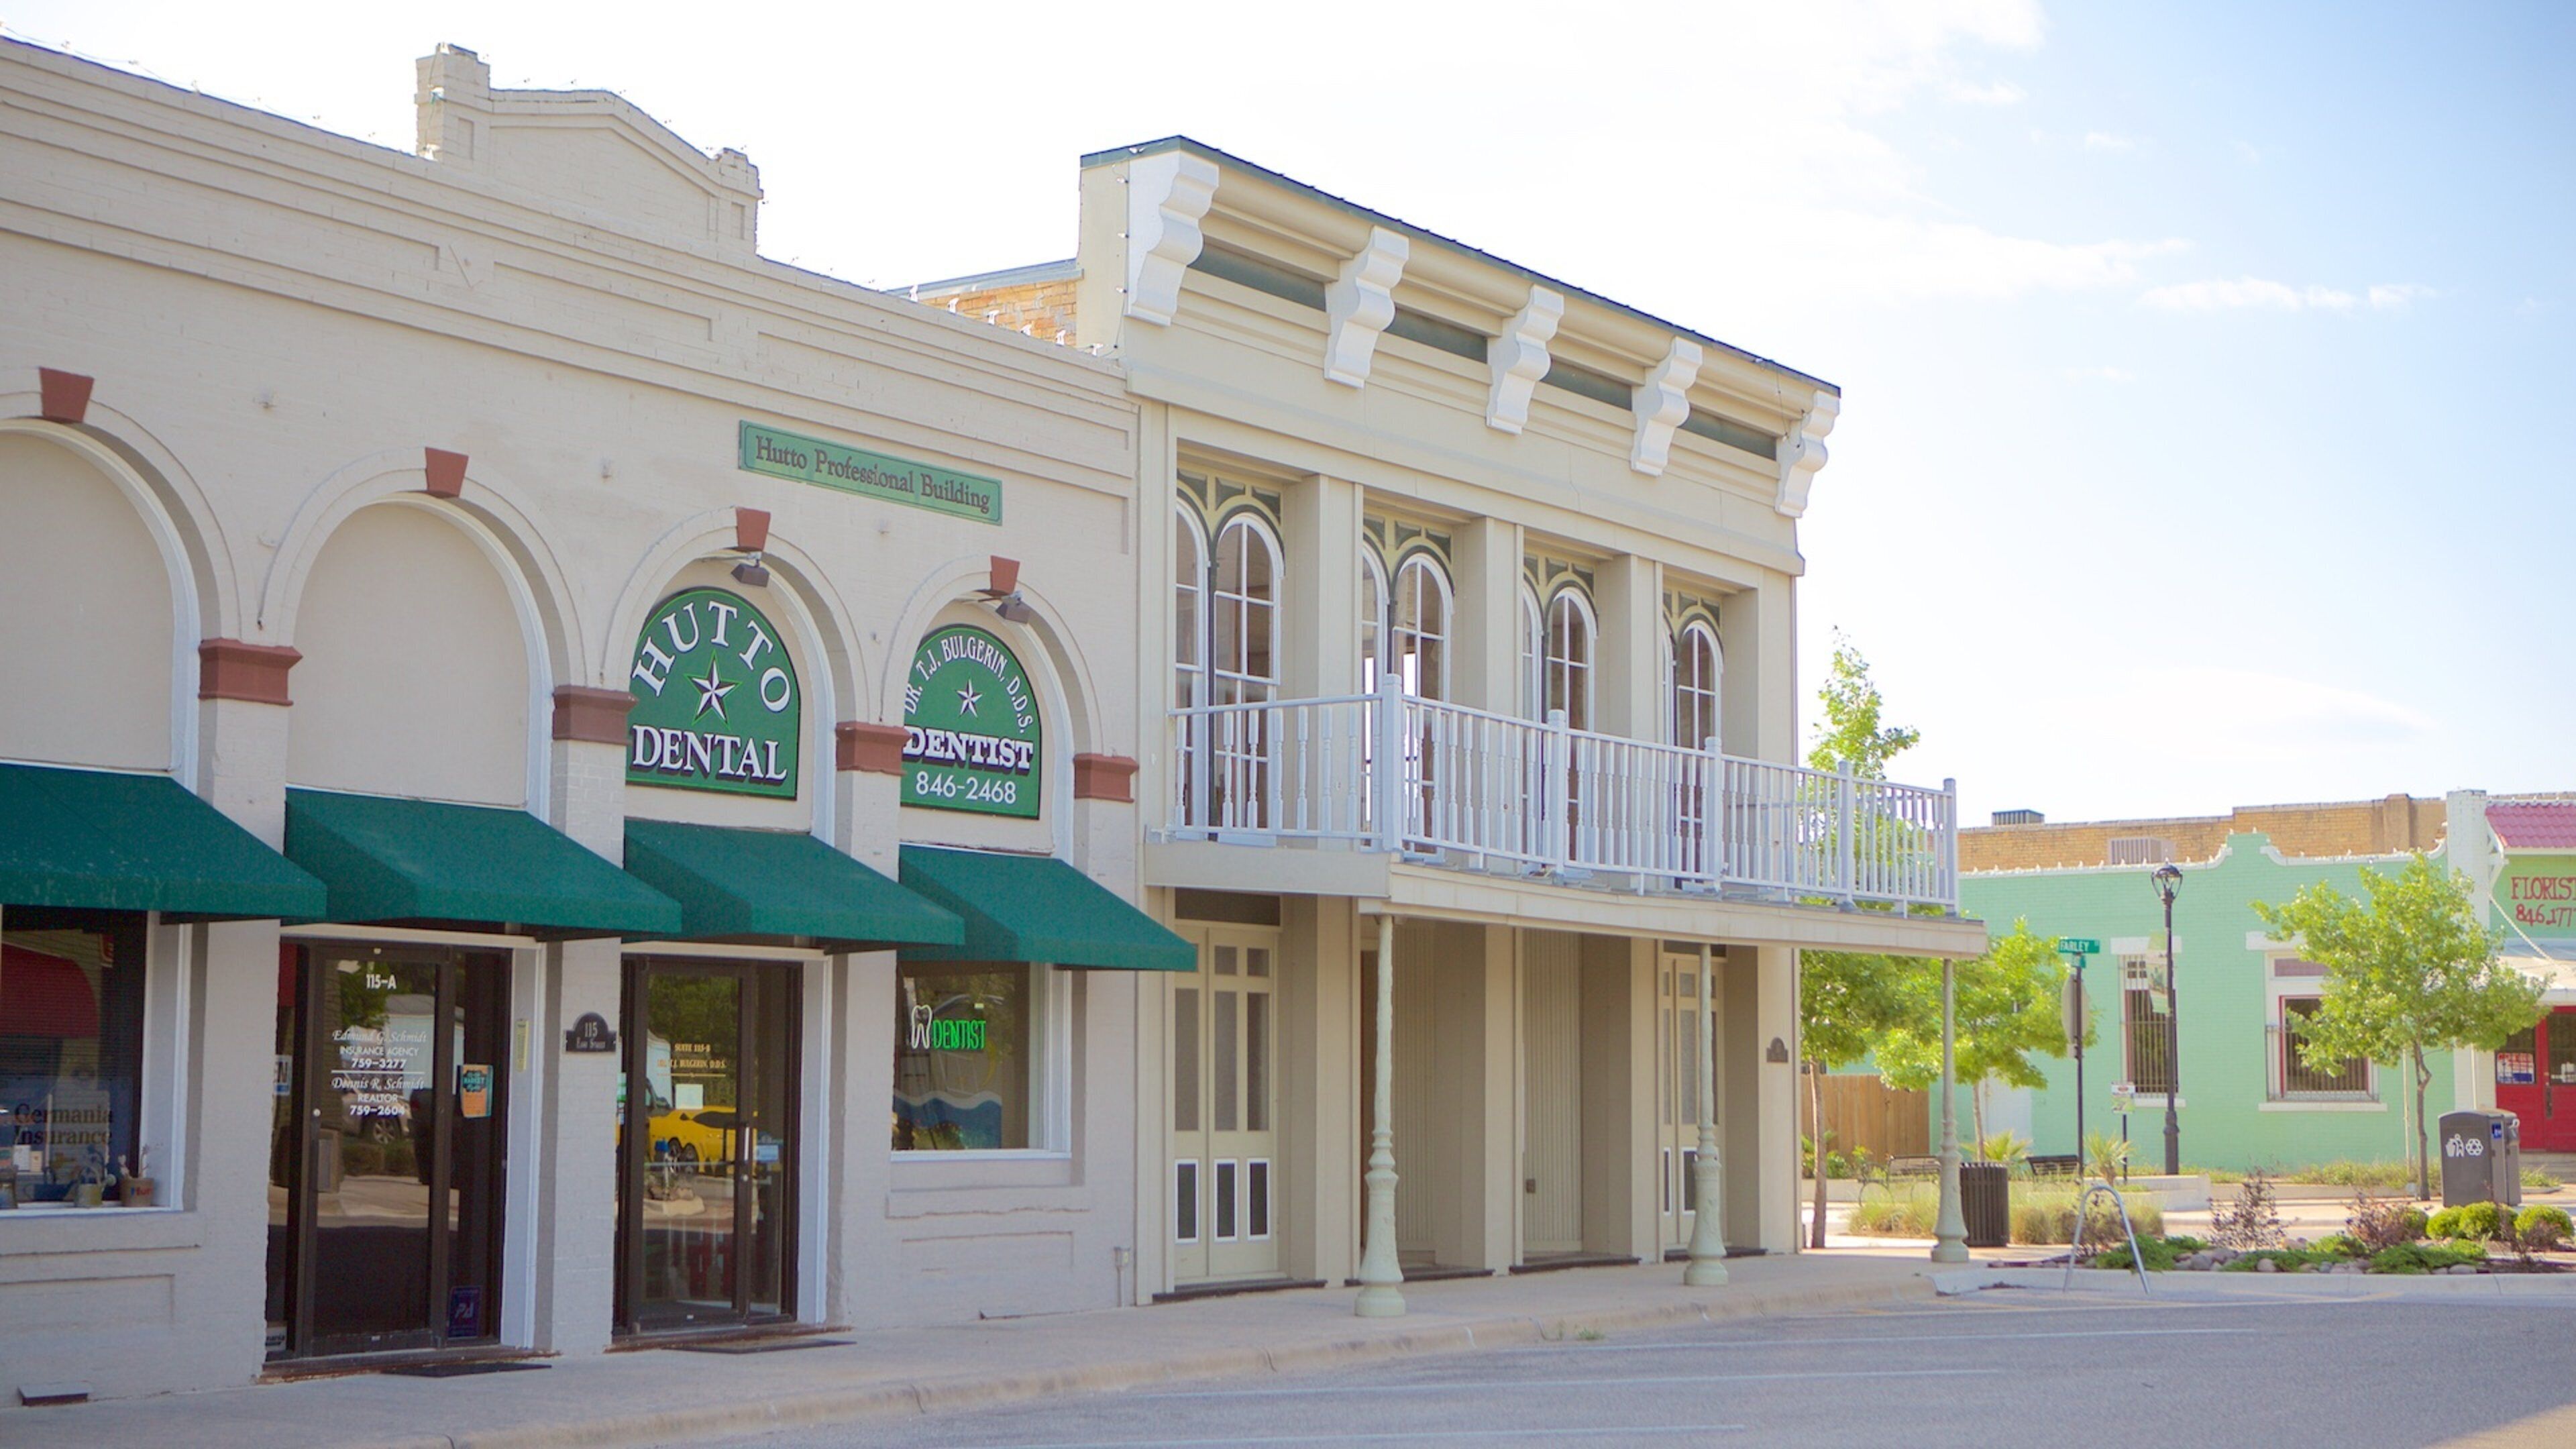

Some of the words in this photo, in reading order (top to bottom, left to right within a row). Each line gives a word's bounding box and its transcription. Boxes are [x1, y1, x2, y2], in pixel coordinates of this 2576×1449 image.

[755, 435, 807, 470] Hutto
[814, 448, 914, 494] Professional
[920, 473, 990, 514] Building
[631, 600, 792, 712] HUTTO
[916, 648, 941, 681] T.J.
[941, 635, 1008, 682] BULGERIN,
[1006, 676, 1033, 734] D.D.S.
[632, 724, 788, 780] DENTAL
[902, 725, 1033, 769] DENTIST
[916, 771, 1016, 804] 846-2468
[366, 974, 396, 989] 115-A
[332, 1030, 374, 1042] Edmund
[390, 1030, 427, 1043] Schmidt
[584, 1022, 598, 1038] 115
[932, 1019, 987, 1050] DENTIST
[339, 1046, 384, 1055] INSURANCE
[386, 1047, 419, 1057] AGENCY
[674, 1043, 692, 1052] SUITE
[351, 1058, 407, 1069] 759-3277
[331, 1077, 369, 1089] Dennis
[384, 1077, 425, 1089] Schmidt
[358, 1094, 398, 1102] REALTOR
[14, 1104, 113, 1124] Germania
[350, 1106, 405, 1116] 759-2604
[14, 1126, 112, 1145] Insurance
